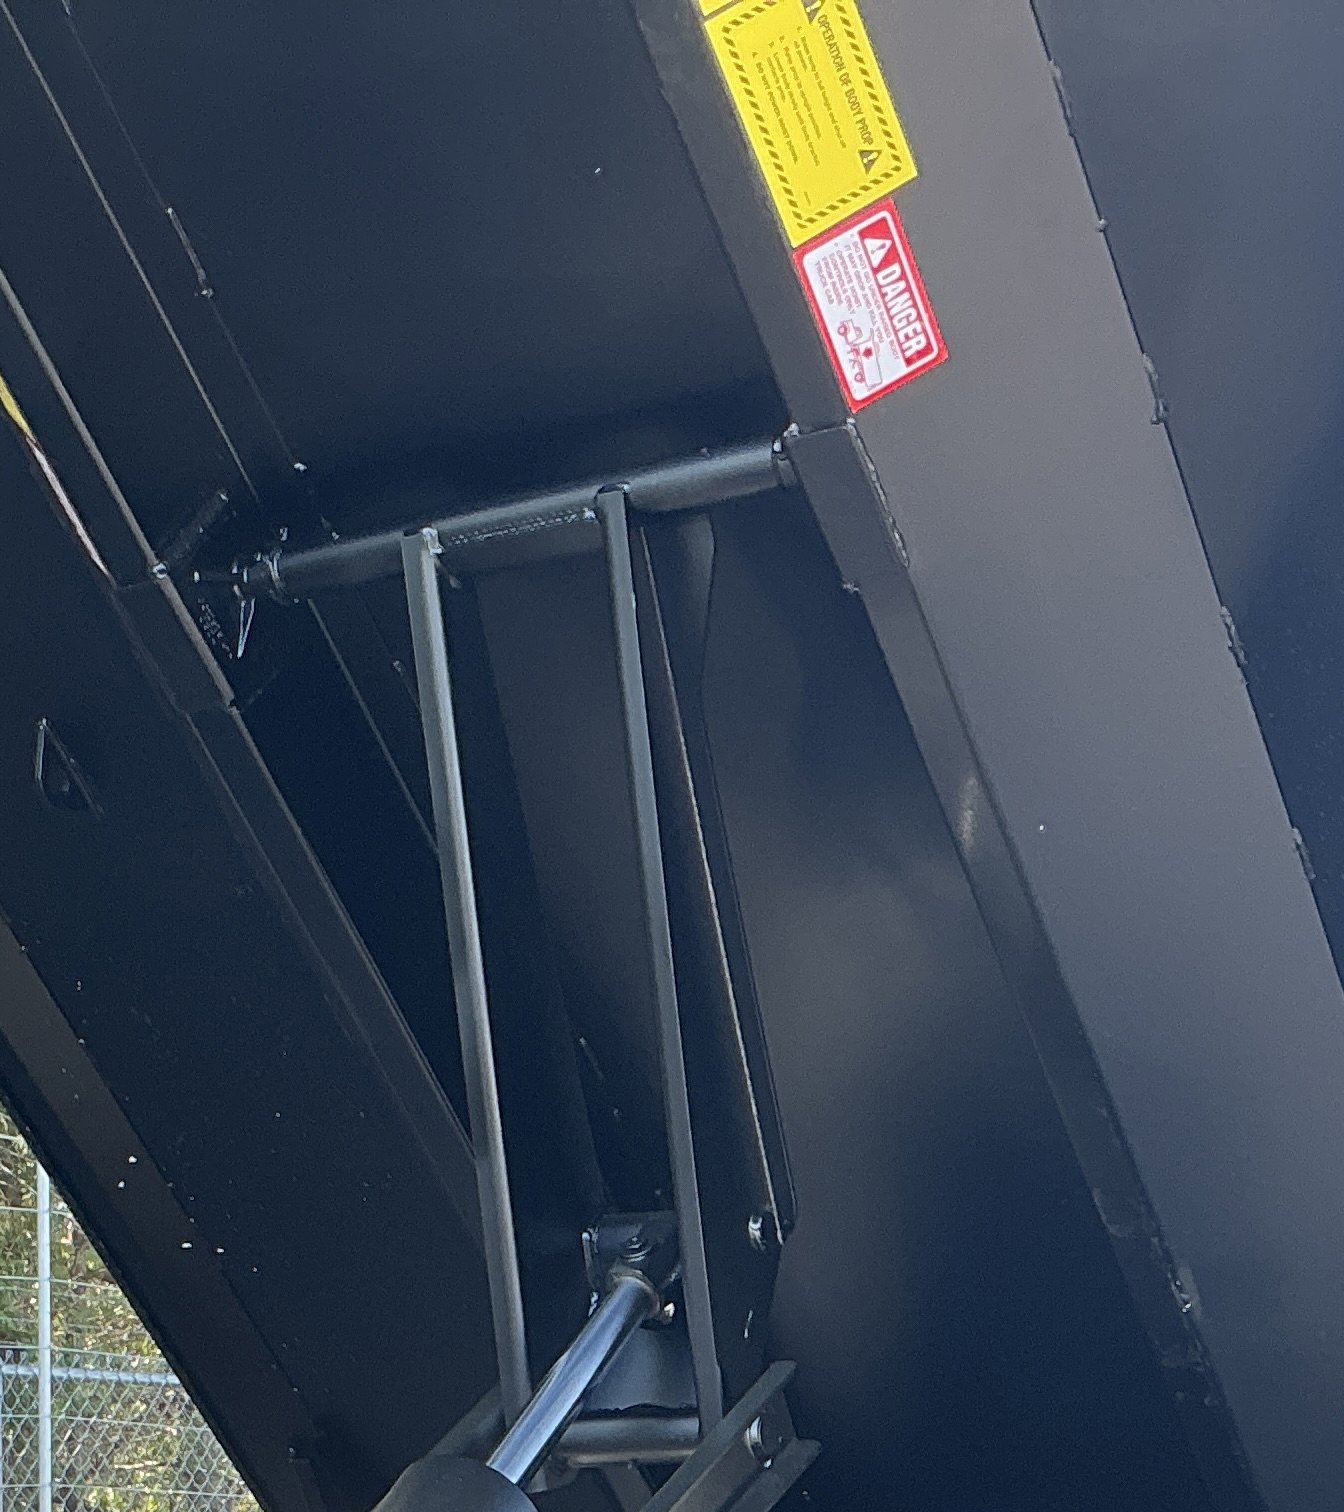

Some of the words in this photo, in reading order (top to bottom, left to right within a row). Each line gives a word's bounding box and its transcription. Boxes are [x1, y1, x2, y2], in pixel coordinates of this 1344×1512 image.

[816, 13, 846, 72] OPERATION
[838, 71, 852, 88] OF
[844, 87, 863, 117] BODY
[855, 117, 874, 147] PROP
[823, 287, 834, 305] CAB
[856, 253, 866, 270] NOT
[888, 338, 900, 361] BODY
[875, 261, 928, 358] DANGER
[874, 326, 884, 344] YOU
